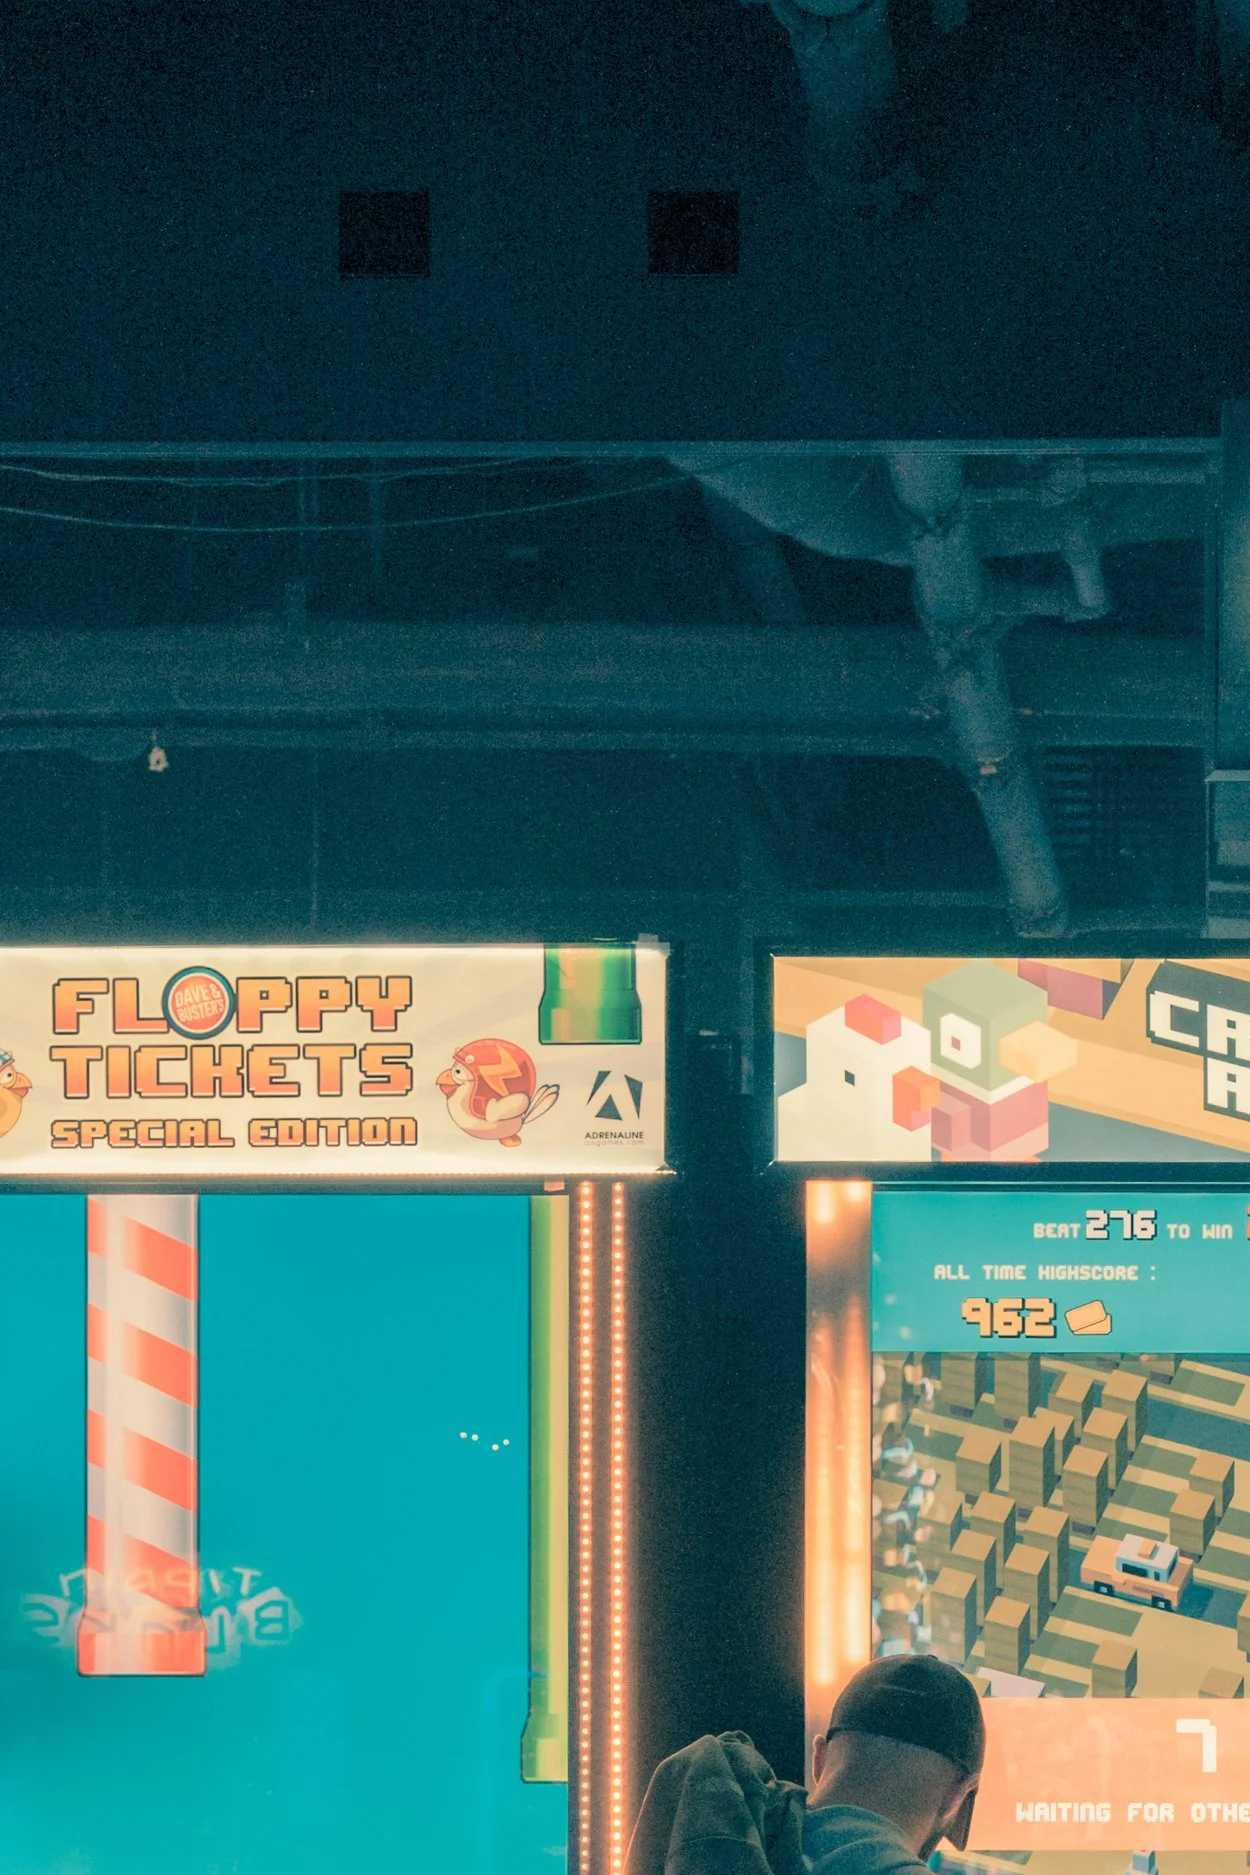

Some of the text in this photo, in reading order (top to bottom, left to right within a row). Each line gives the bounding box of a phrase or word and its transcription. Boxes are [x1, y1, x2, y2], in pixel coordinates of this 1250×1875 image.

[175, 984, 221, 1008] DAVE &
[50, 1043, 413, 1099] TICKETS
[51, 1117, 418, 1149] SPECIAL EDITION
[584, 1131, 645, 1139] ADRENALINE
[1033, 1223, 1081, 1239] BEAT
[1085, 1209, 1158, 1241] 276
[1167, 1223, 1190, 1239] TO
[1202, 1223, 1233, 1240] WIN
[934, 1264, 970, 1280] ALL
[982, 1264, 1027, 1280] TIME
[1038, 1265, 1139, 1281] HIGHSCORE
[961, 1298, 1057, 1339] 962
[1176, 1718, 1217, 1773] 7
[1016, 1802, 1112, 1823] WAITING
[1127, 1802, 1175, 1823] FOR
